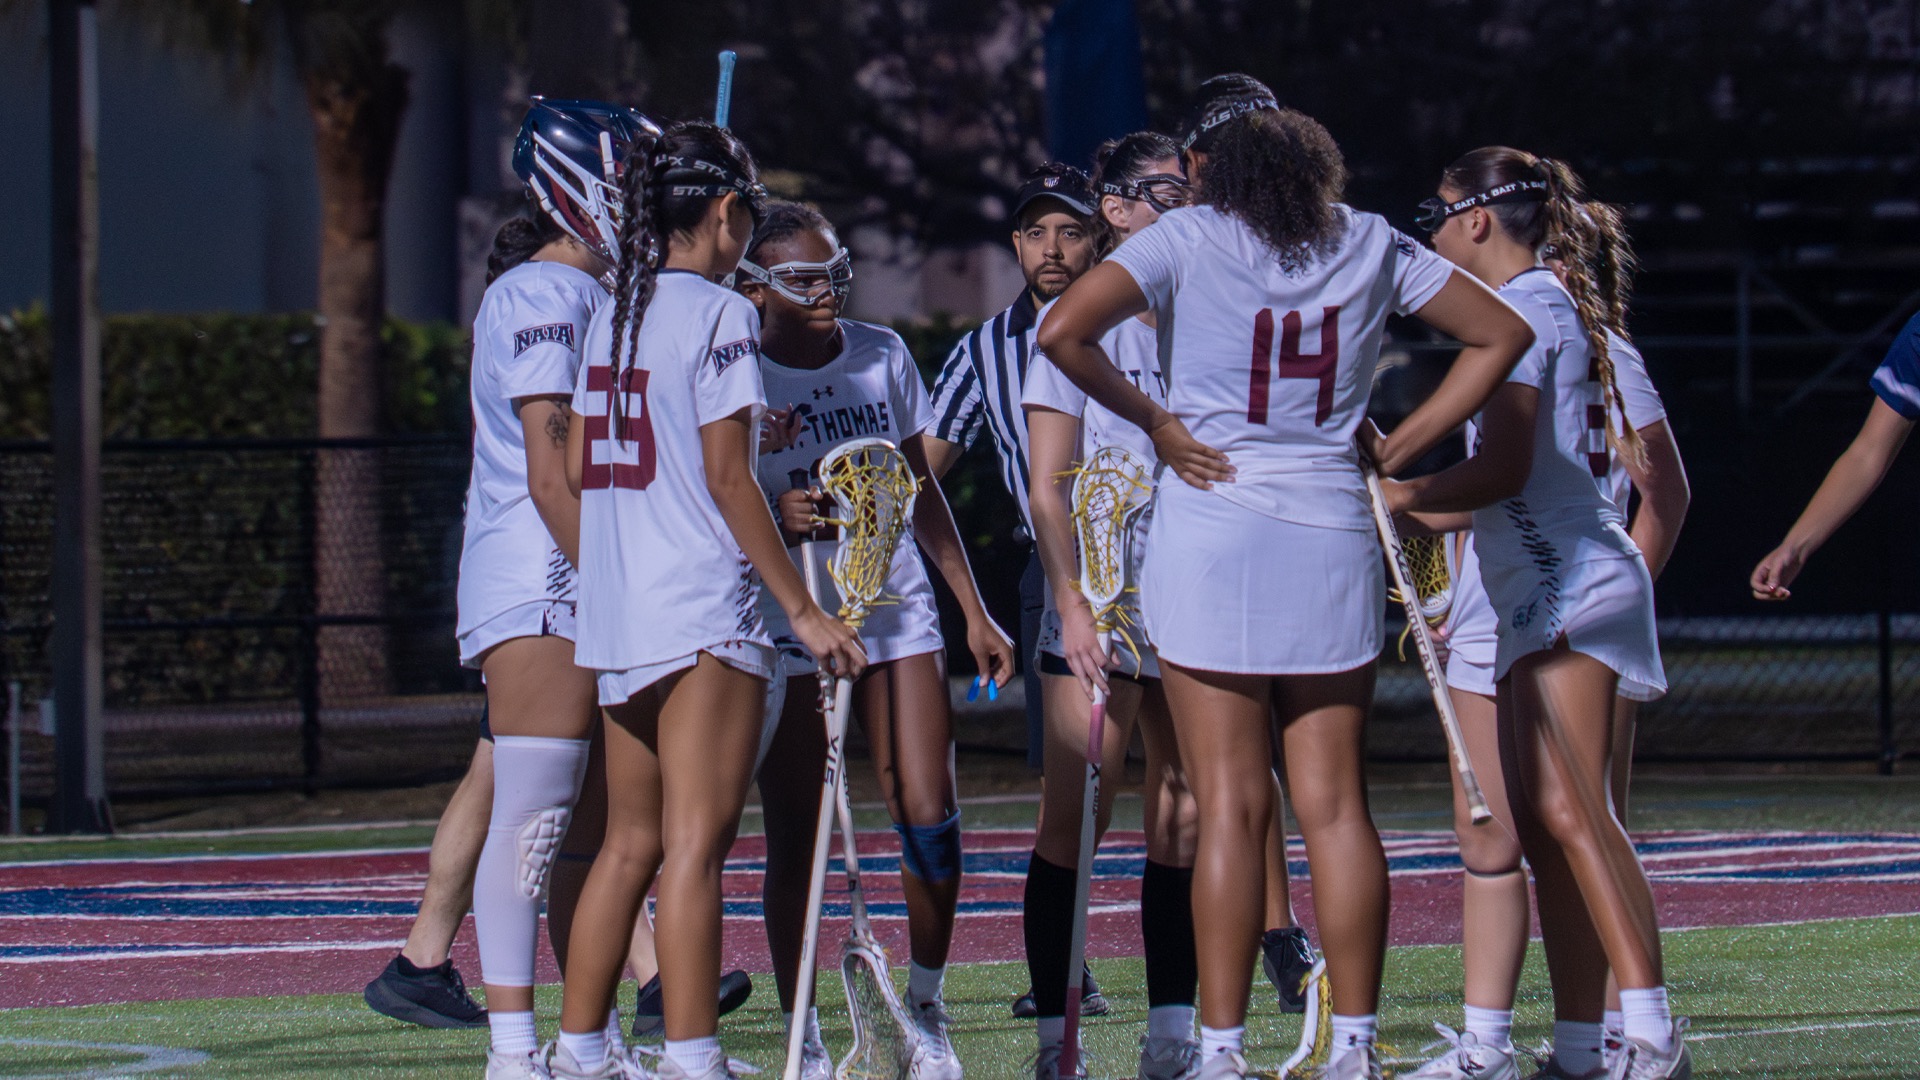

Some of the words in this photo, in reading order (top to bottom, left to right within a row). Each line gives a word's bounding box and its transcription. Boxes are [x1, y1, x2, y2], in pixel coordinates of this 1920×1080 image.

[694, 161, 727, 179] STX
[673, 186, 707, 195] STX
[1103, 184, 1122, 195] STX
[1454, 198, 1476, 211] GAIT
[1491, 184, 1515, 196] GAIT
[516, 325, 573, 351] NAIA
[712, 339, 757, 371] NAI
[1248, 306, 1340, 428] 14
[806, 402, 890, 444] THOMAS
